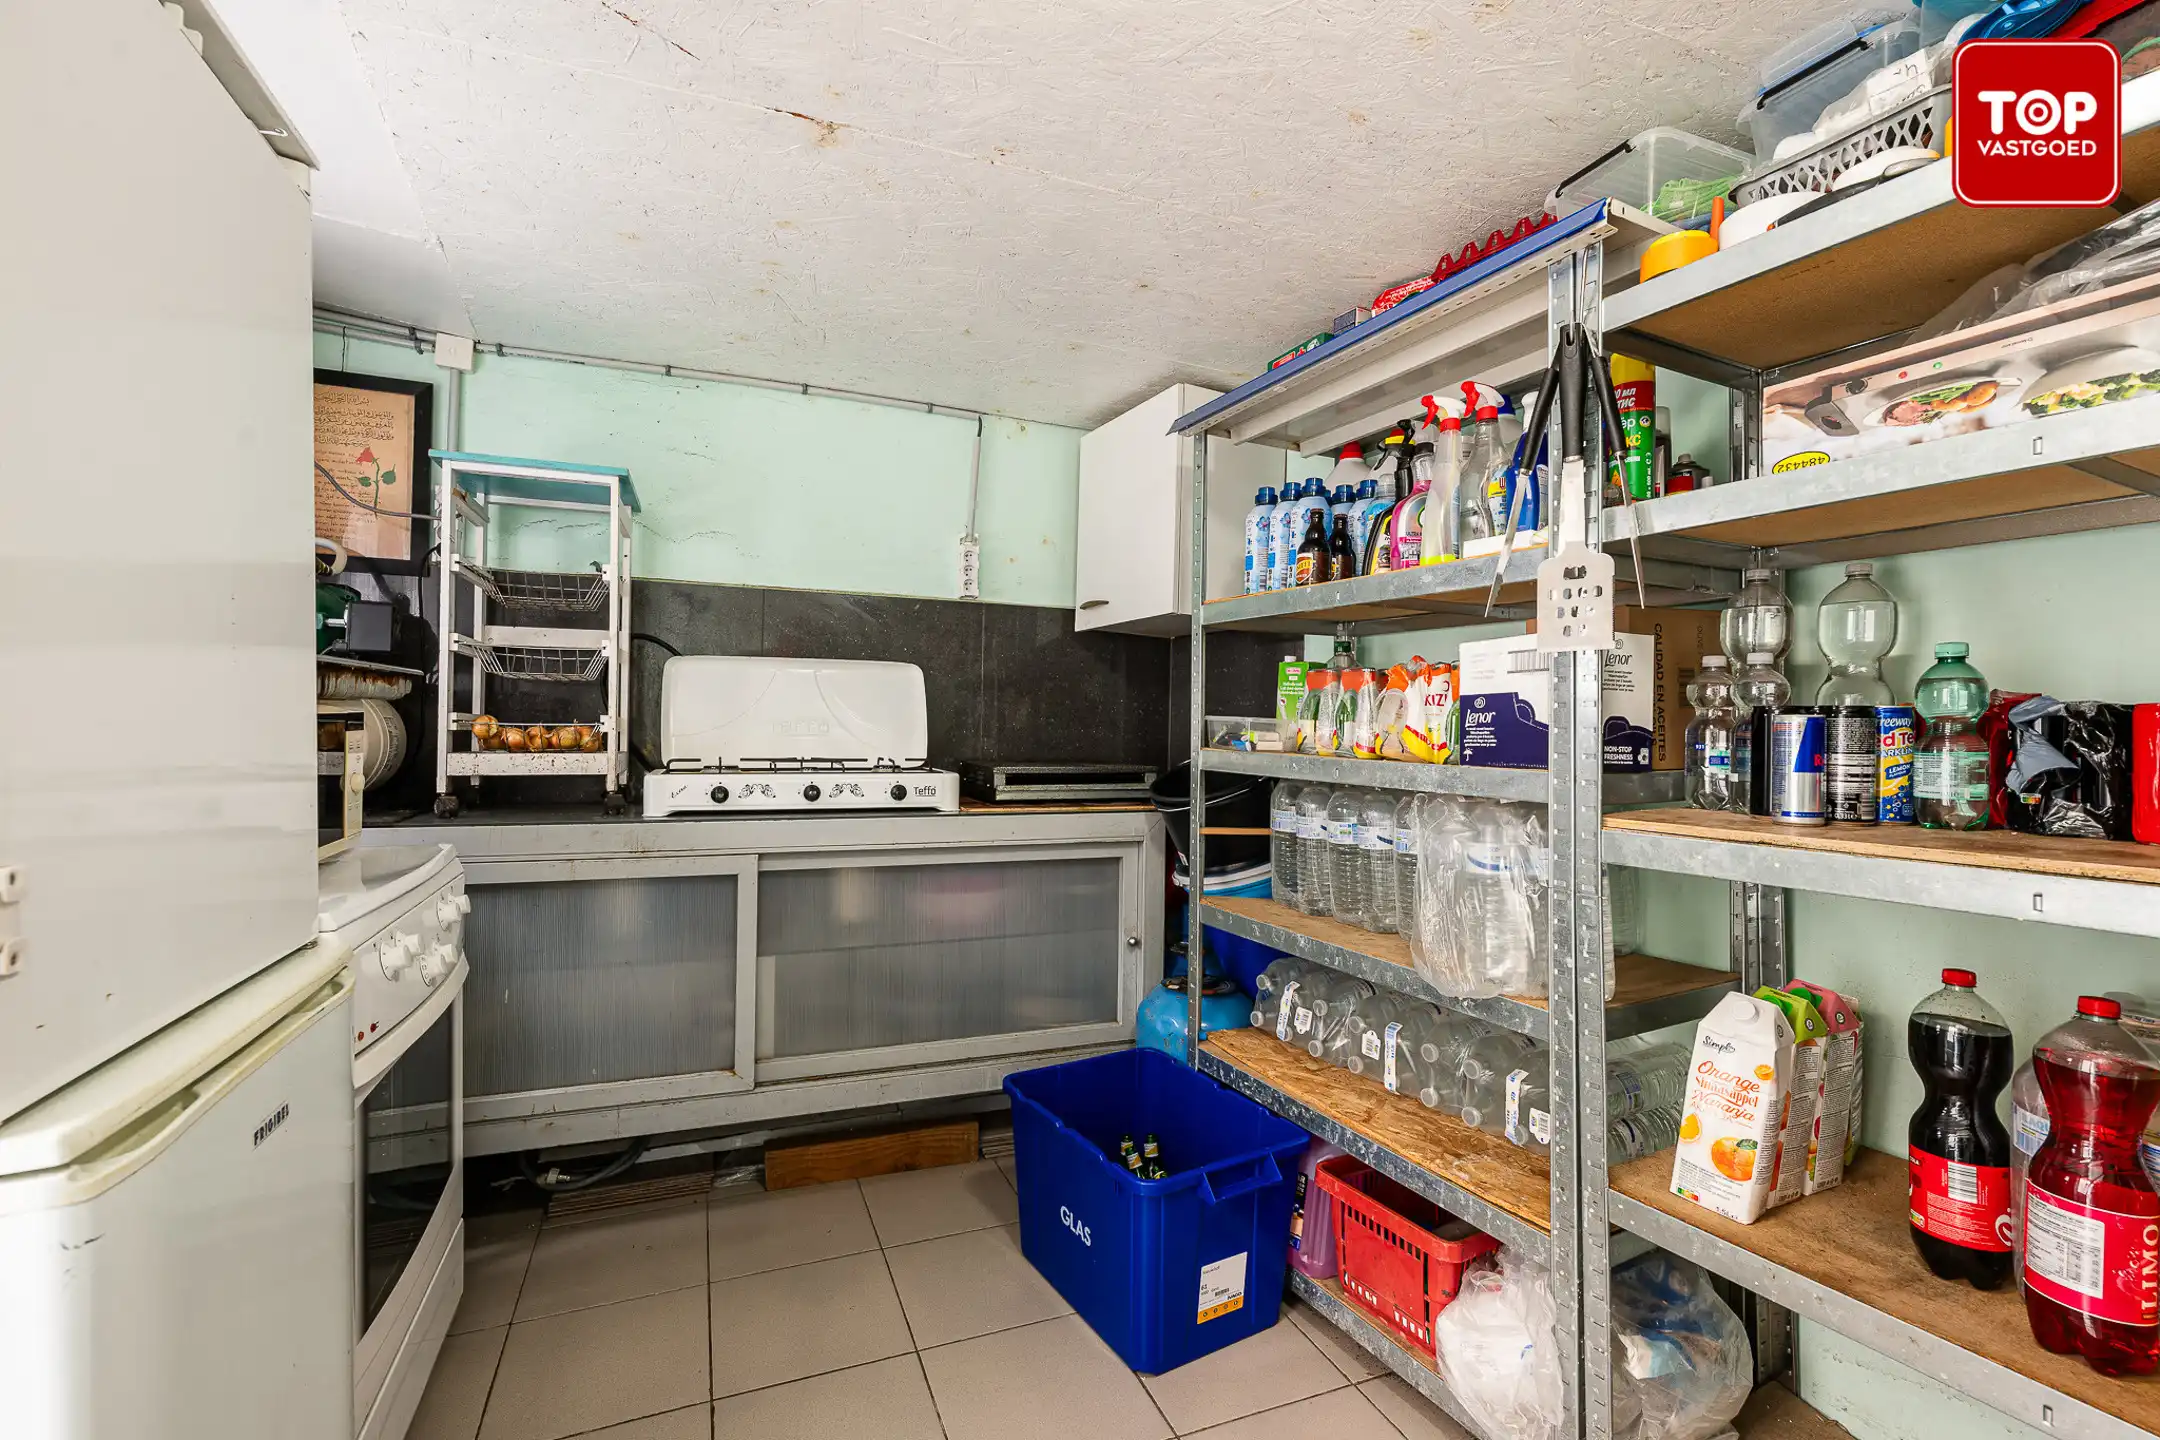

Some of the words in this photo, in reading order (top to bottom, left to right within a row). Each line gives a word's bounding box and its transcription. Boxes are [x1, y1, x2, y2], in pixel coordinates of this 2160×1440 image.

[1617, 397, 1636, 409] ТИС
[1604, 650, 1633, 667] Lenor
[1654, 623, 1664, 681] CALIDAD
[1656, 684, 1664, 703] EN
[1465, 709, 1496, 727] Lenor
[1880, 717, 1912, 728] reeway
[1657, 706, 1667, 762] ACEITES
[1899, 731, 1914, 746] Te
[1889, 764, 1911, 774] LEMON
[913, 786, 936, 796] Teffo
[1697, 1060, 1760, 1093] Orange
[1691, 1089, 1756, 1121] Naranja
[1060, 1205, 1091, 1247] GLAS
